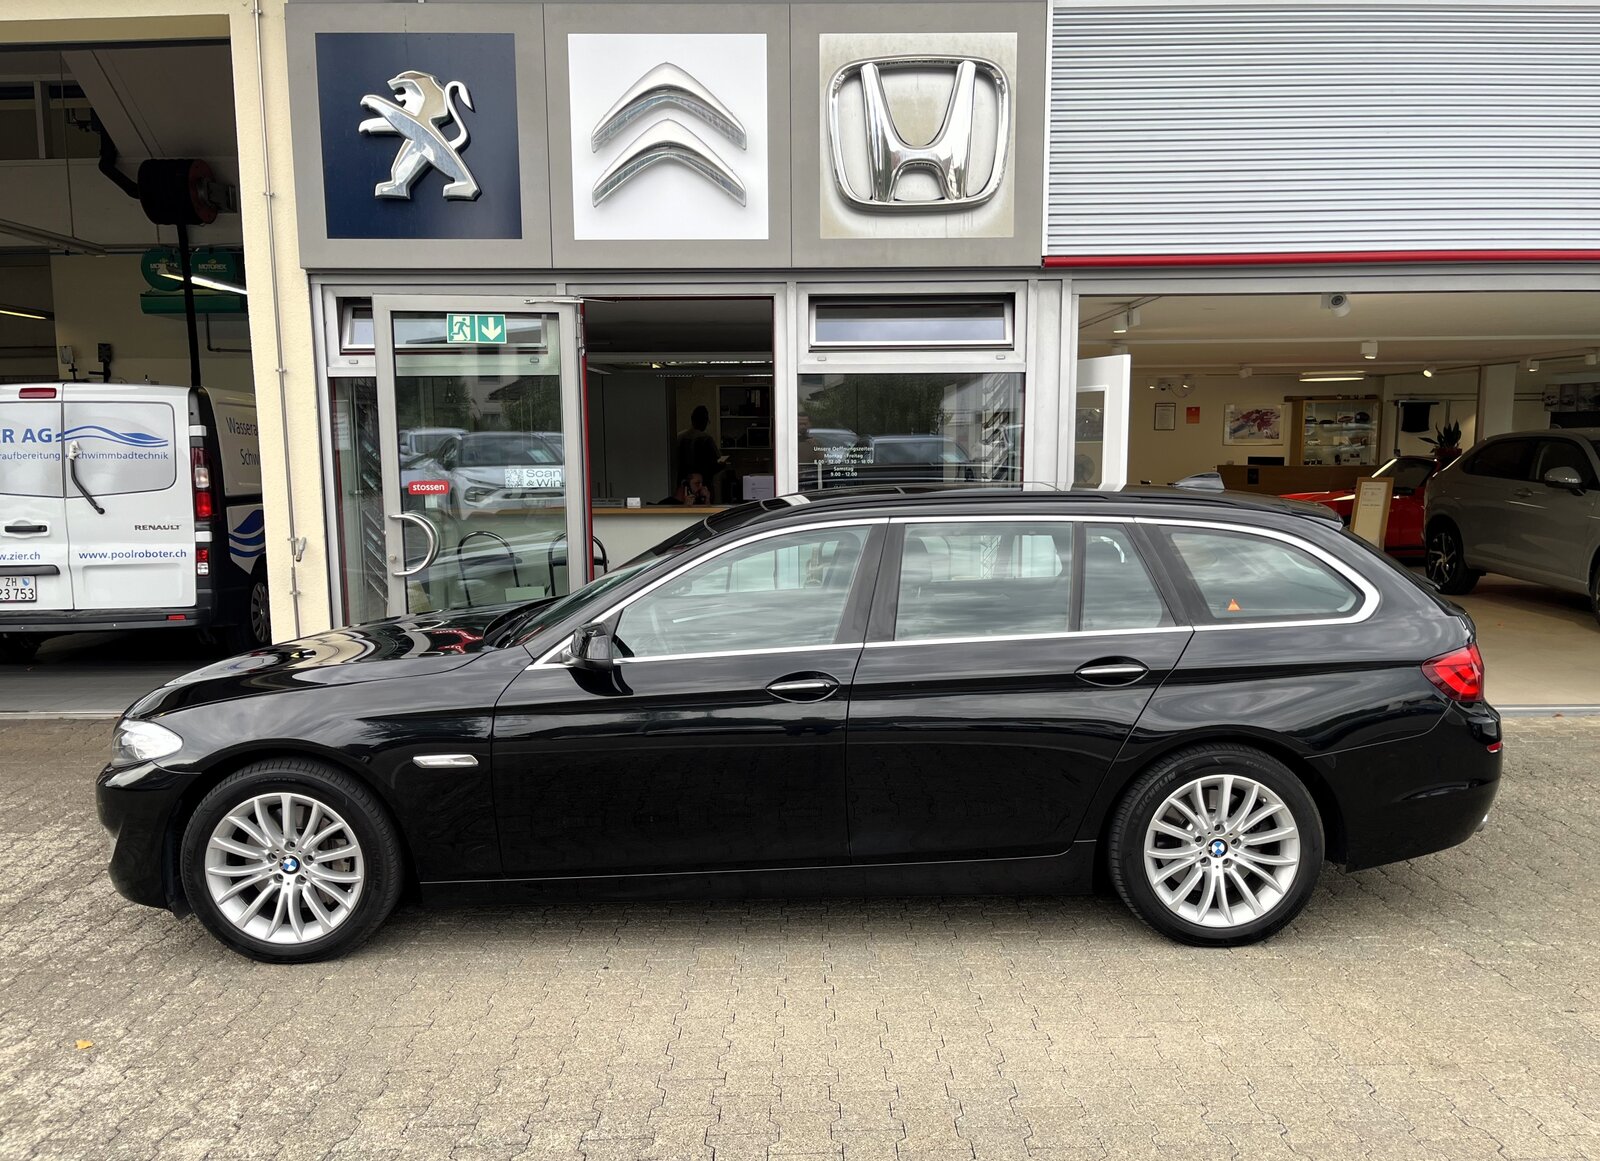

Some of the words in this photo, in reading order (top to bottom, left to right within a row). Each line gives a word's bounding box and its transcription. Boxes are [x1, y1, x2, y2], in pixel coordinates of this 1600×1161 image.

[0, 428, 15, 443] R
[21, 428, 52, 443] AG
[76, 451, 169, 460] chwimmbadtechnik
[526, 469, 561, 478] Scan
[412, 483, 445, 491] stossen
[536, 478, 561, 487] Win
[78, 548, 187, 561] www.poolroboter.ch
[5, 577, 17, 587] ZH
[1135, 771, 1177, 816] MICHELIN
